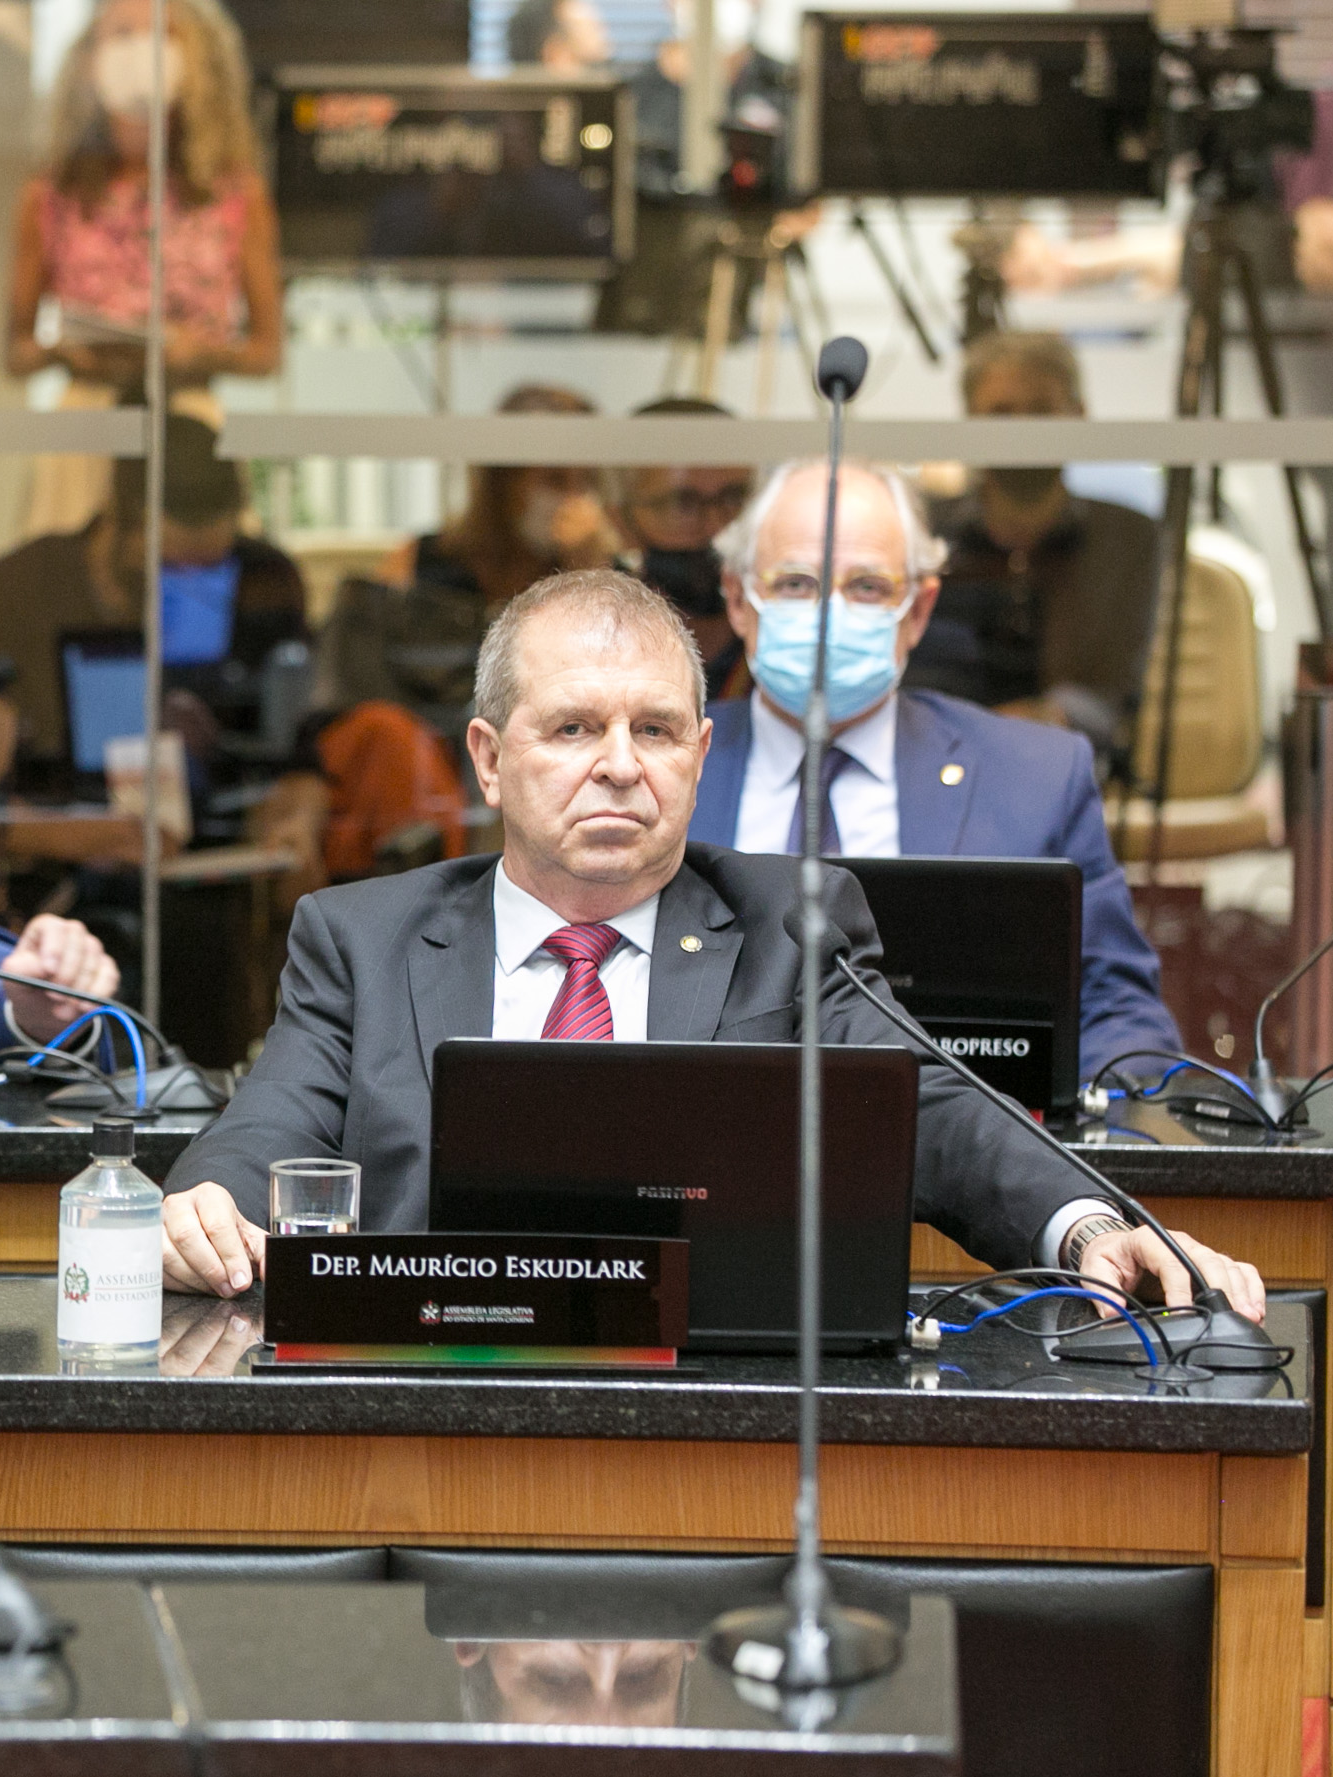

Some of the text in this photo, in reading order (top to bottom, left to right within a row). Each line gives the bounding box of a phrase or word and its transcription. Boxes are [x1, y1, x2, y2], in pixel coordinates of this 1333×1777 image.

[932, 1037, 1031, 1057] ROPRESO
[369, 1253, 497, 1278] MAURÍCIO
[505, 1256, 646, 1279] ESKUDLARK
